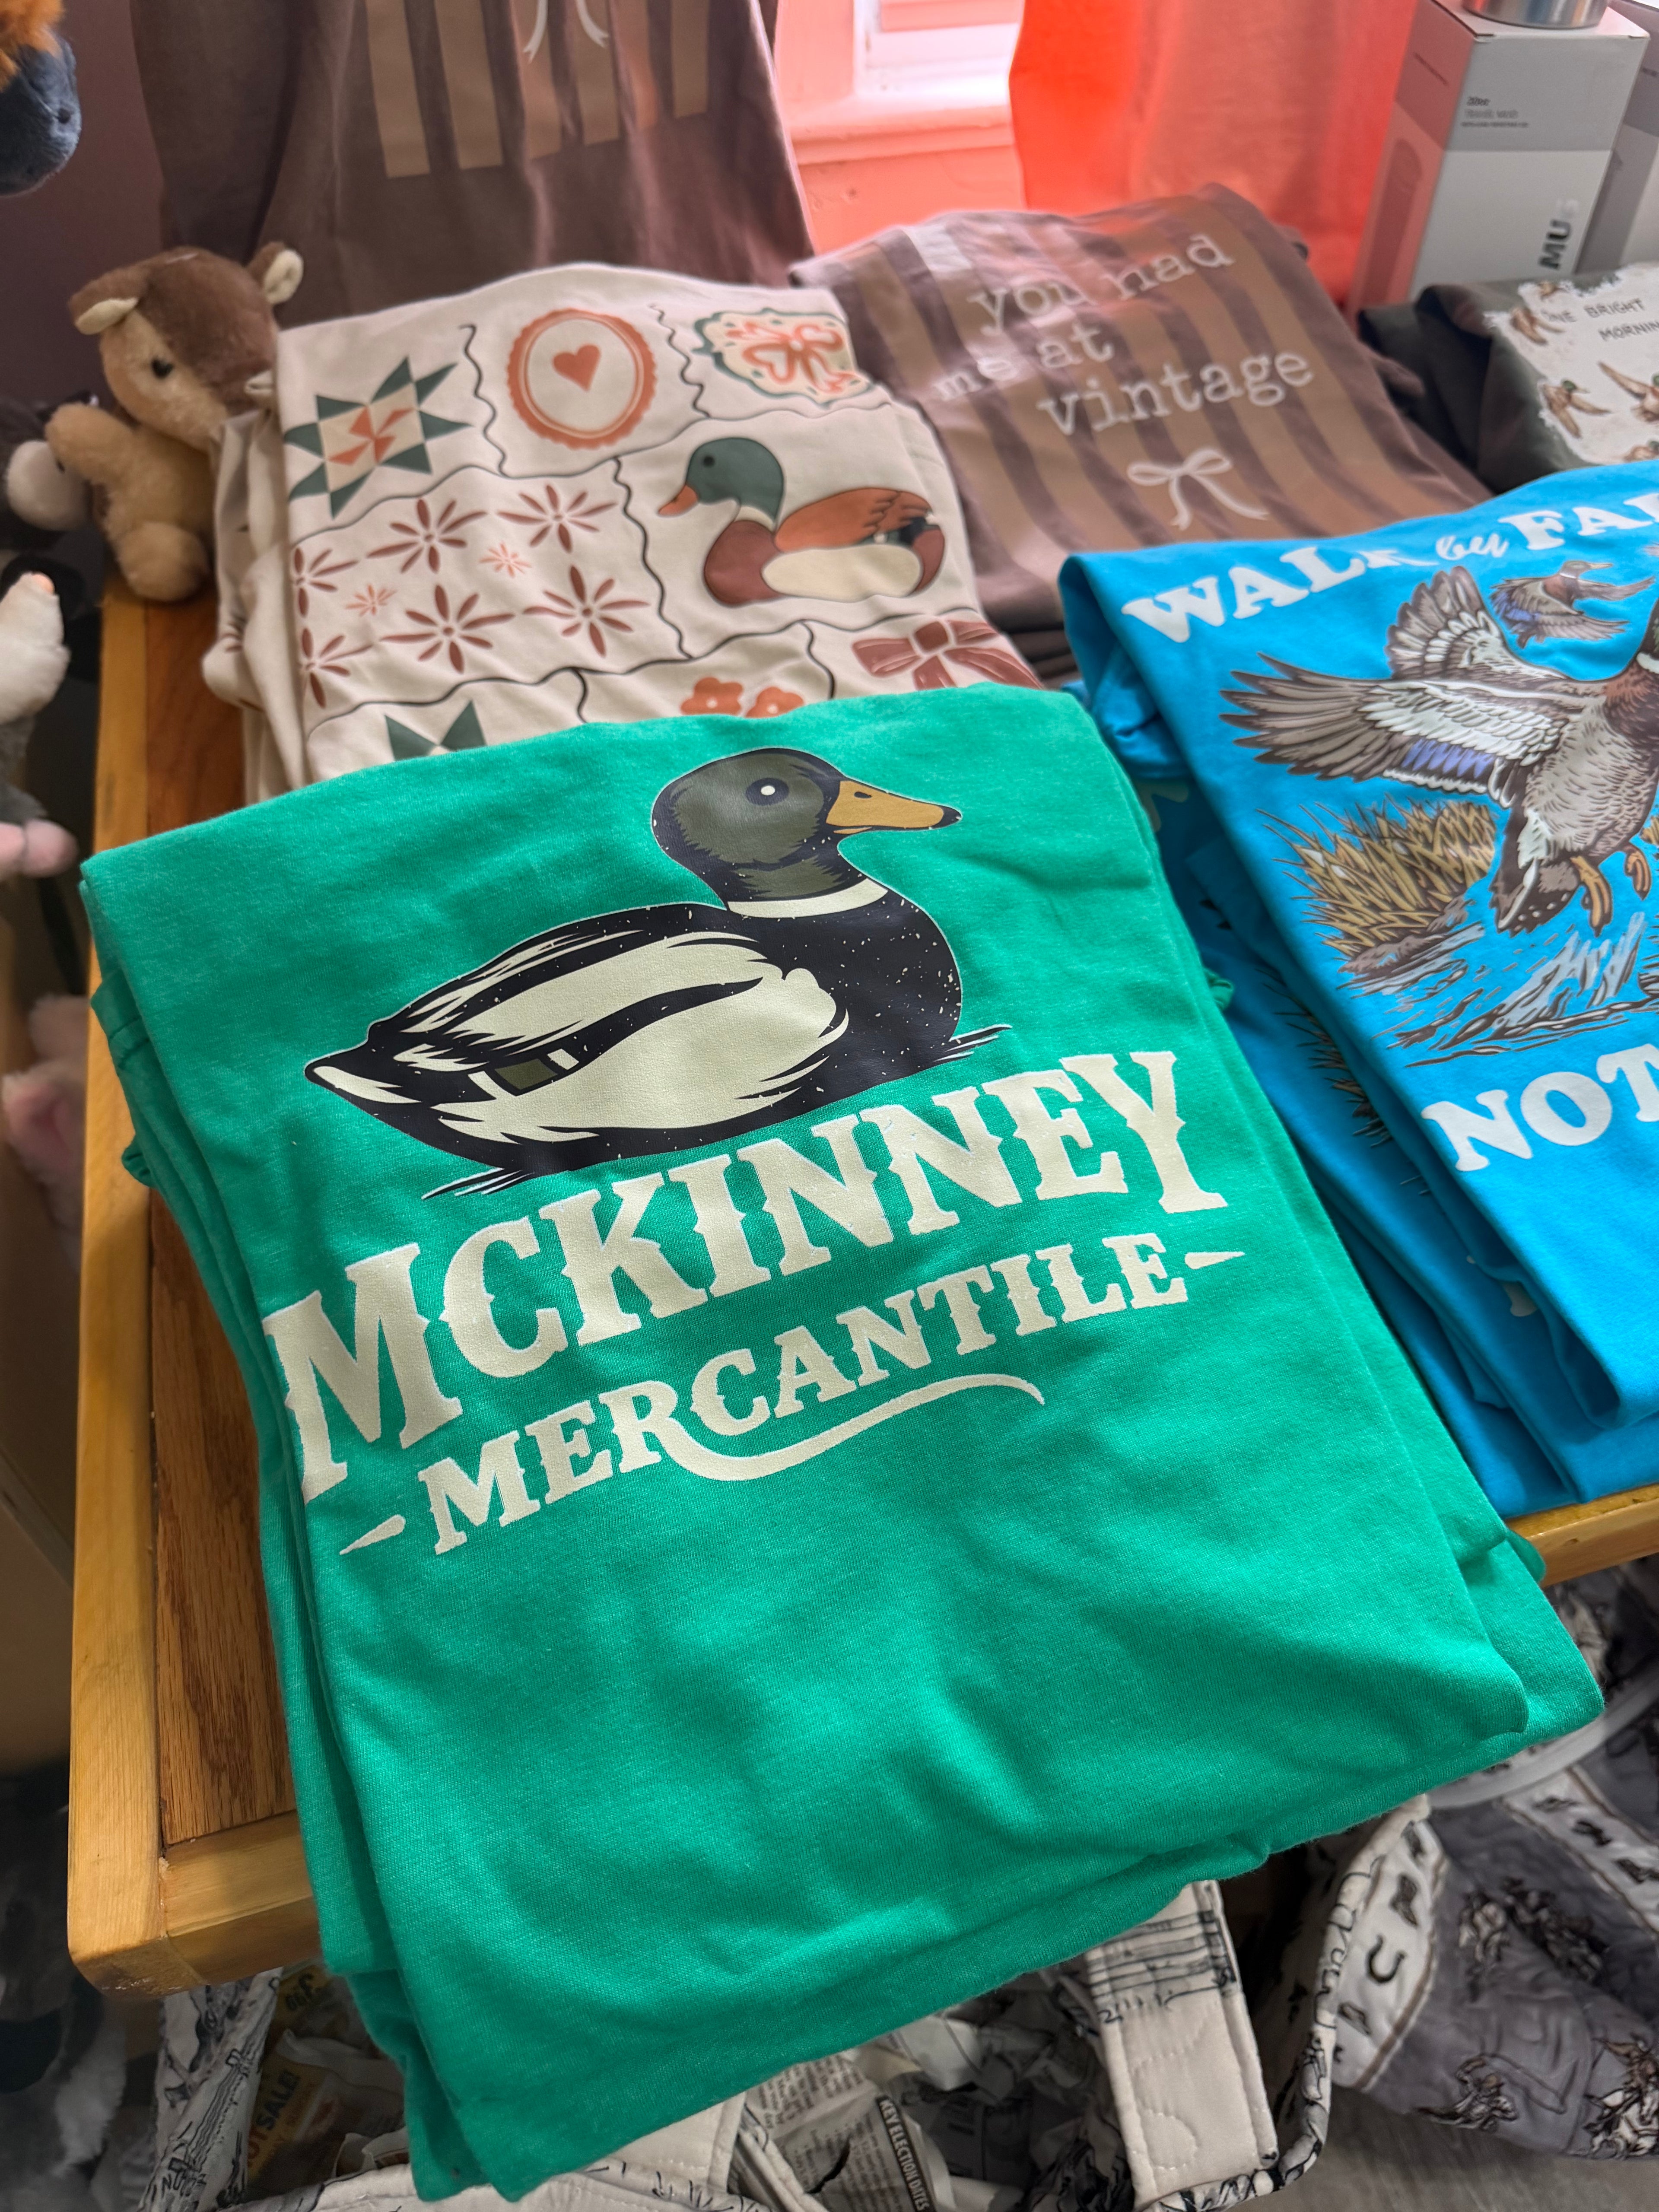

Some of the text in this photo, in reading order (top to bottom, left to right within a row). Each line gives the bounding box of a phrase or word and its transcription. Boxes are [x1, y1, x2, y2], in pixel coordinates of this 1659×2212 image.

[969, 232, 1235, 336] you had
[1583, 298, 1645, 318] BRIGHT
[931, 322, 1113, 400] me at
[1038, 352, 1314, 435] vintage
[1122, 547, 1438, 643] WALK
[1421, 1043, 1659, 1171] NOT
[262, 1051, 1228, 1504] MCKINNEY
[418, 1232, 1188, 1555] MERCANTILE
[878, 2098, 931, 2212] KEY ELECTION DATES
